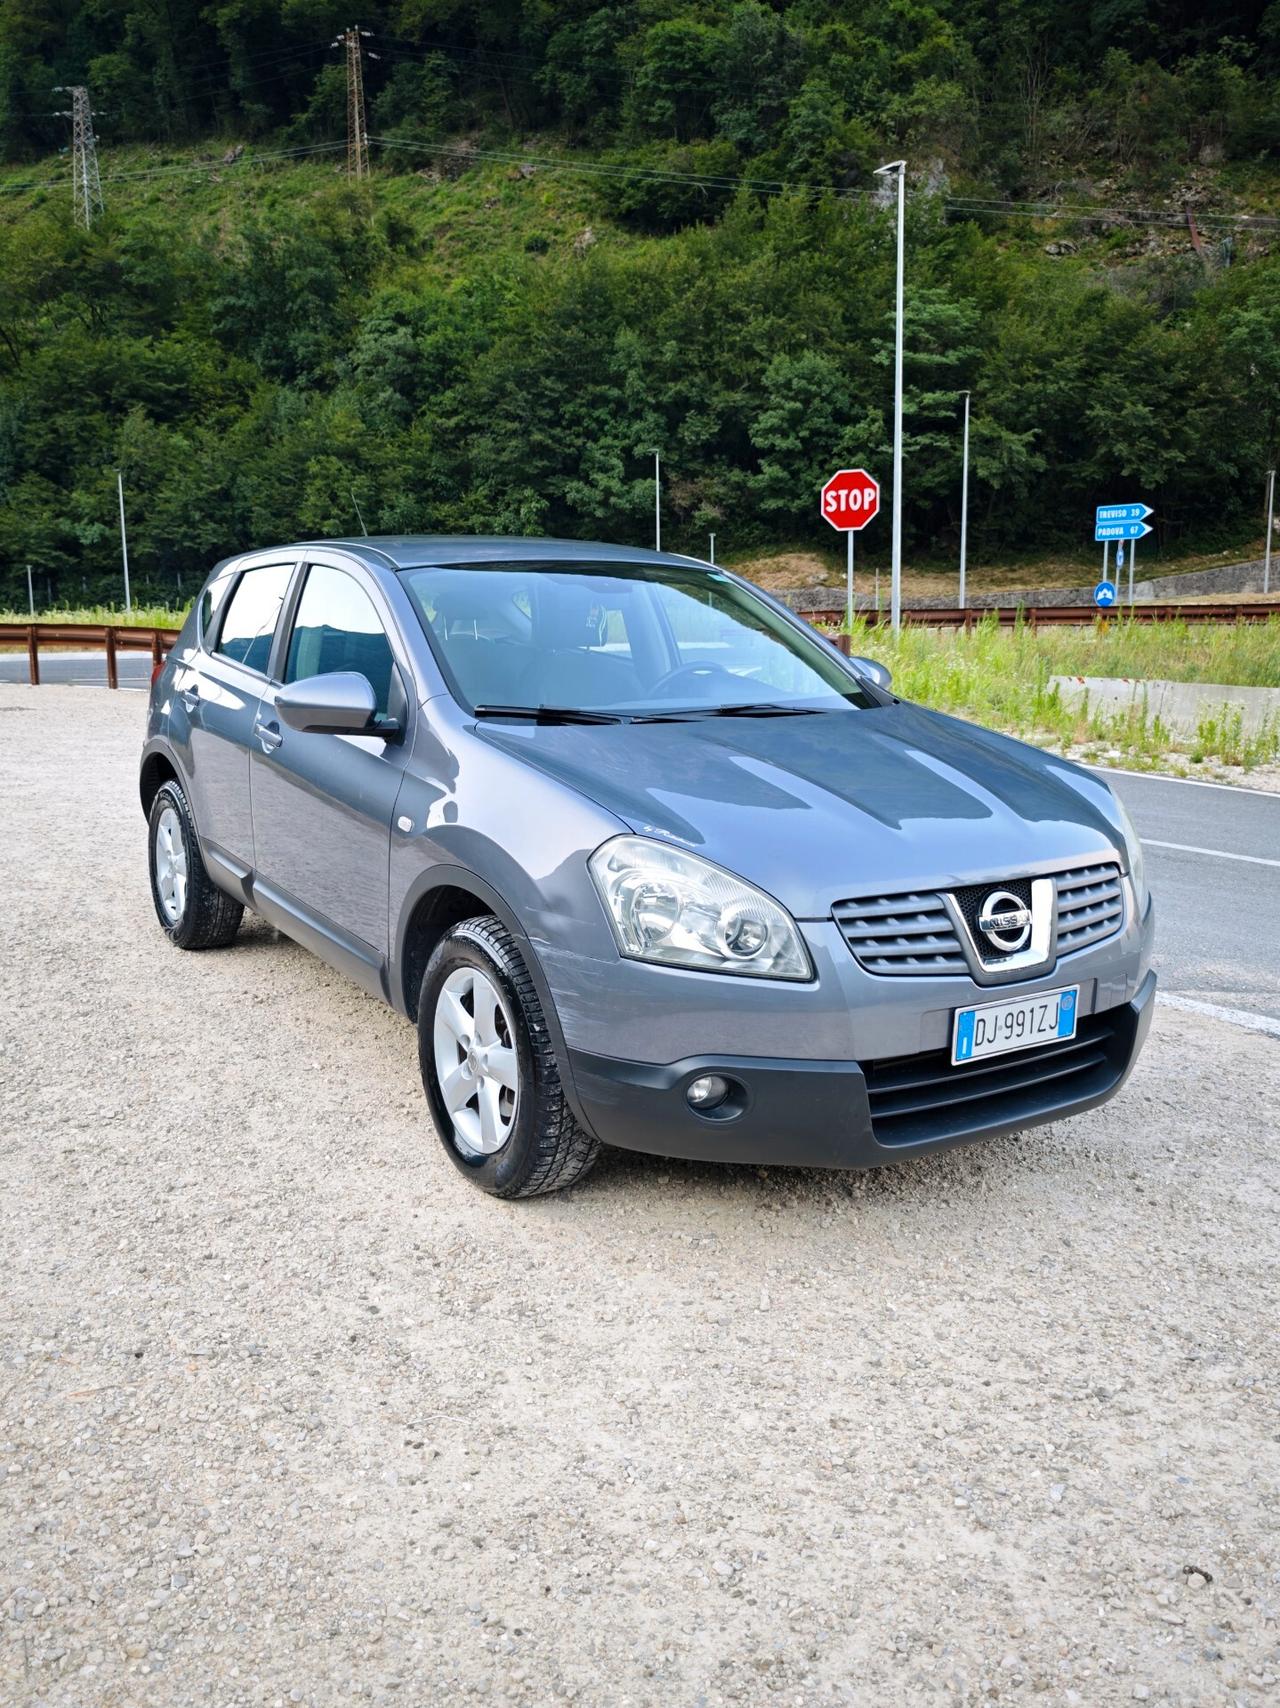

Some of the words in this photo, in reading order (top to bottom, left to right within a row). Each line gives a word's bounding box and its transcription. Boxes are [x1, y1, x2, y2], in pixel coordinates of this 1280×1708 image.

[825, 487, 876, 513] STOP
[1099, 509, 1127, 519] TREVISO
[1097, 526, 1124, 537] PADOVA
[1130, 525, 1139, 535] 67
